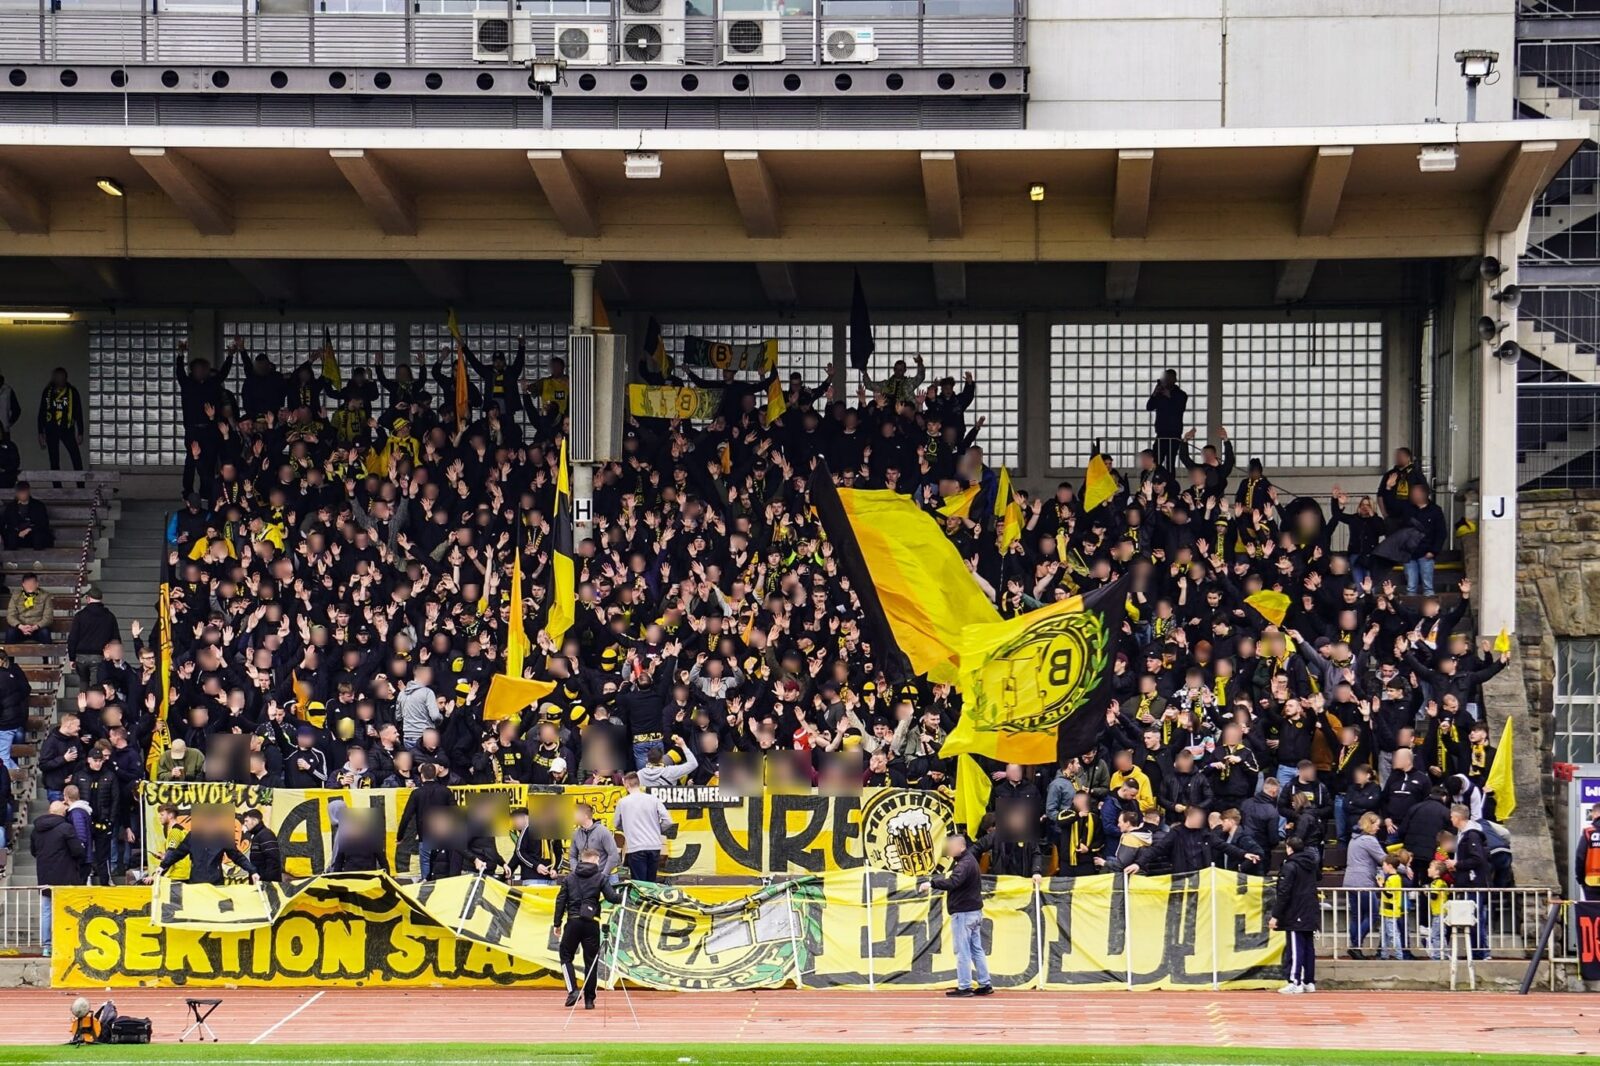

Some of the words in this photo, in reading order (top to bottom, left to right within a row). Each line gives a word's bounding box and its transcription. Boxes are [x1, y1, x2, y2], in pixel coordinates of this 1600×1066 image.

[575, 500, 591, 520] H
[1491, 496, 1505, 518] J
[651, 787, 696, 804] POLIZIA
[697, 787, 740, 803] MER
[81, 909, 368, 976] SEKTION
